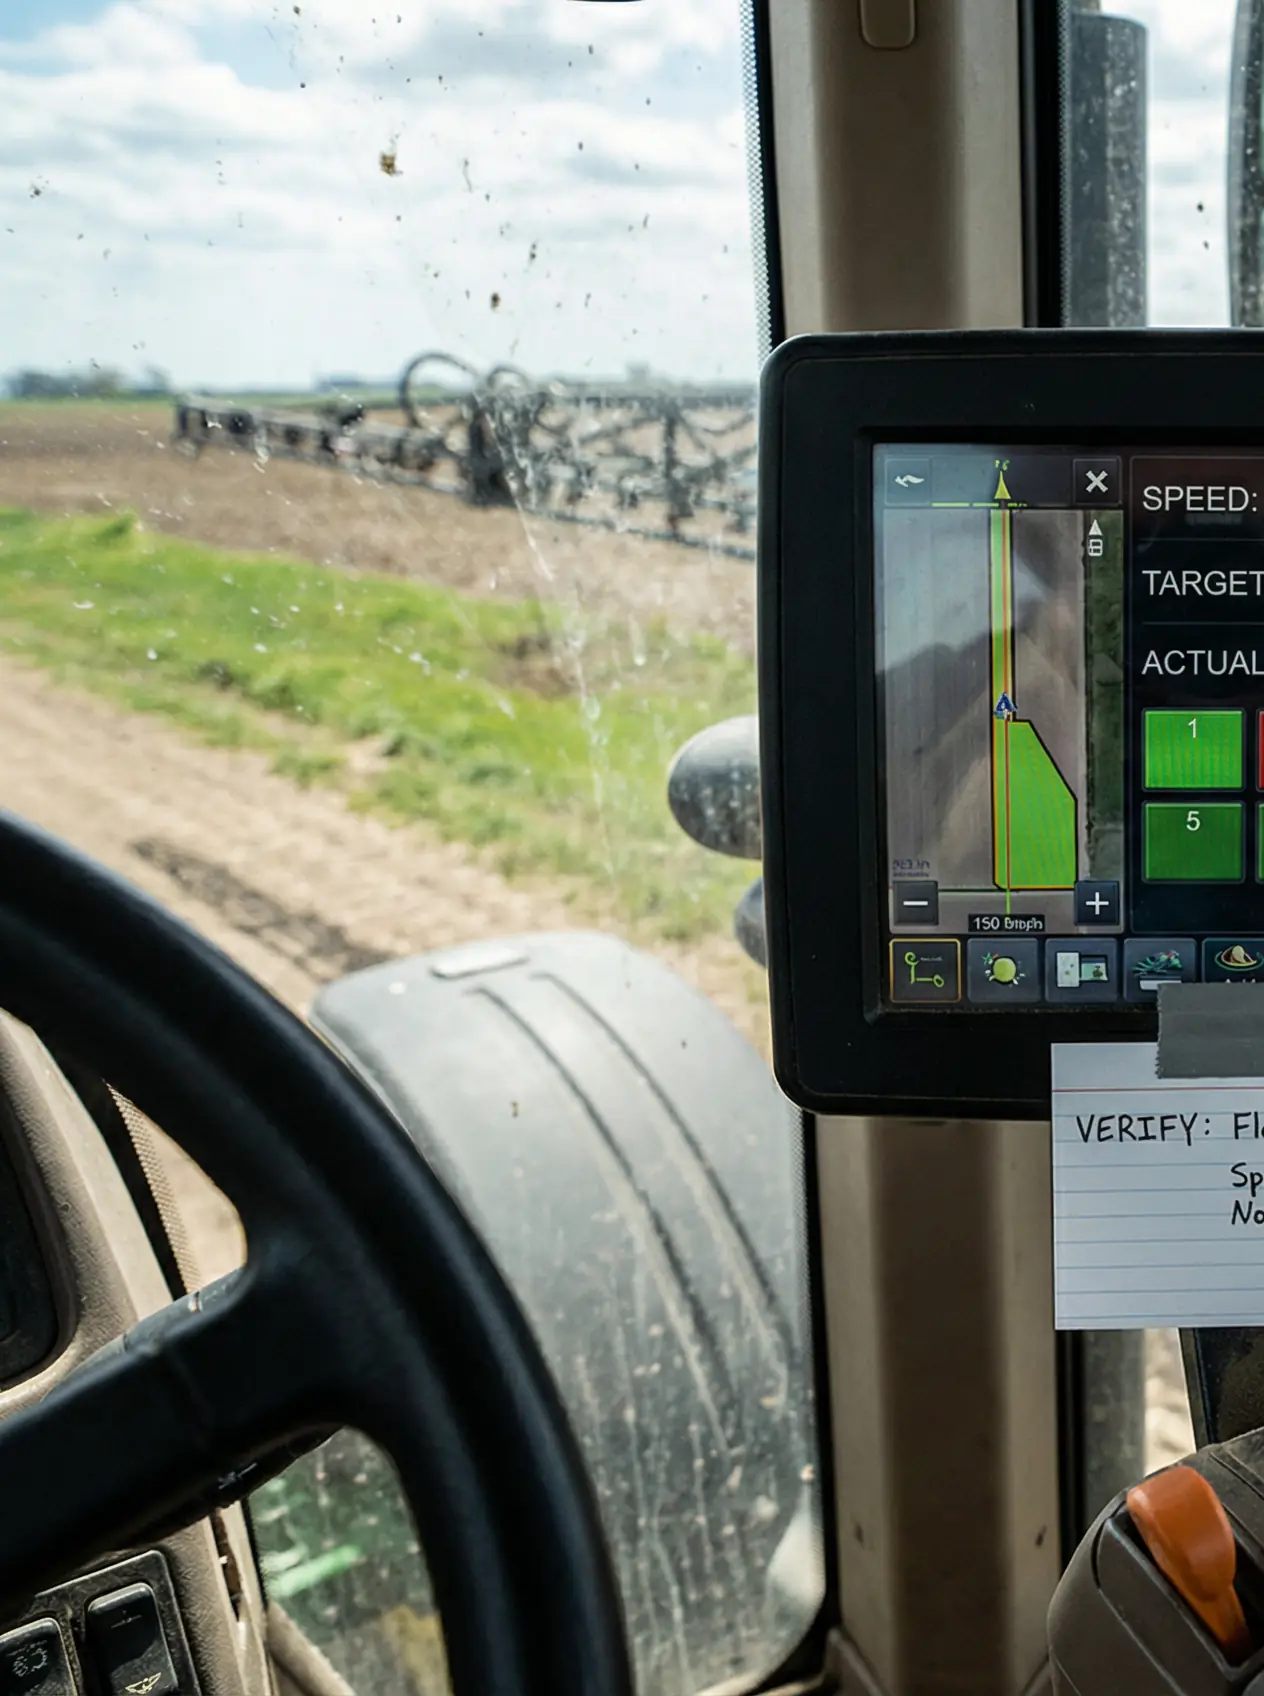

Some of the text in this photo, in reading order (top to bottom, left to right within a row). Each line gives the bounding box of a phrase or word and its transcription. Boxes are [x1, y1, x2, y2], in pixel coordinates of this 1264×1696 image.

[1142, 485, 1257, 512] SPEED:
[1187, 718, 1197, 739] 1
[1186, 810, 1201, 831] 5
[1076, 1112, 1210, 1147] VERIFY:
